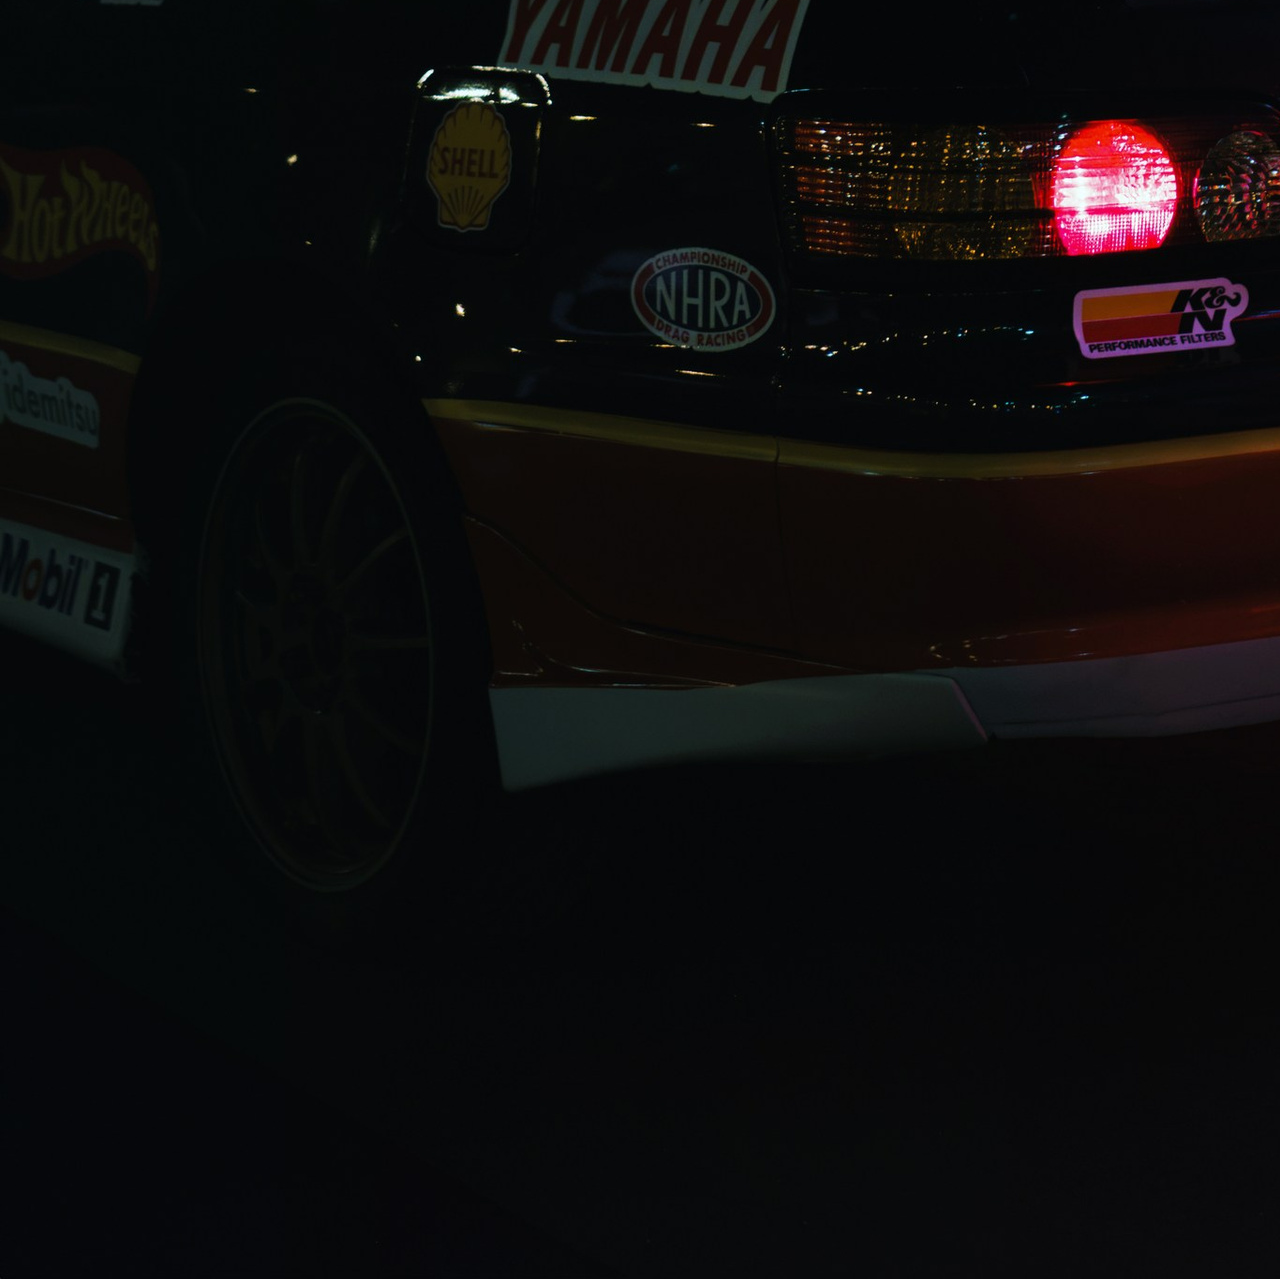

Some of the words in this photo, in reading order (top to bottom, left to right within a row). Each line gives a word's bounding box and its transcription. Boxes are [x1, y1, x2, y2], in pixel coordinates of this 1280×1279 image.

[438, 147, 499, 178] SHELL
[0, 155, 66, 263] Hot
[655, 251, 749, 276] CHAMPIONSHIP
[656, 269, 752, 329] NHRA
[655, 318, 690, 343] DRAG
[697, 329, 746, 347] RACING
[1088, 336, 1178, 353] PERFORMANCE
[1180, 331, 1226, 345] FILTERS
[2, 368, 98, 436] idemitsu
[0, 532, 83, 616] Mobil
